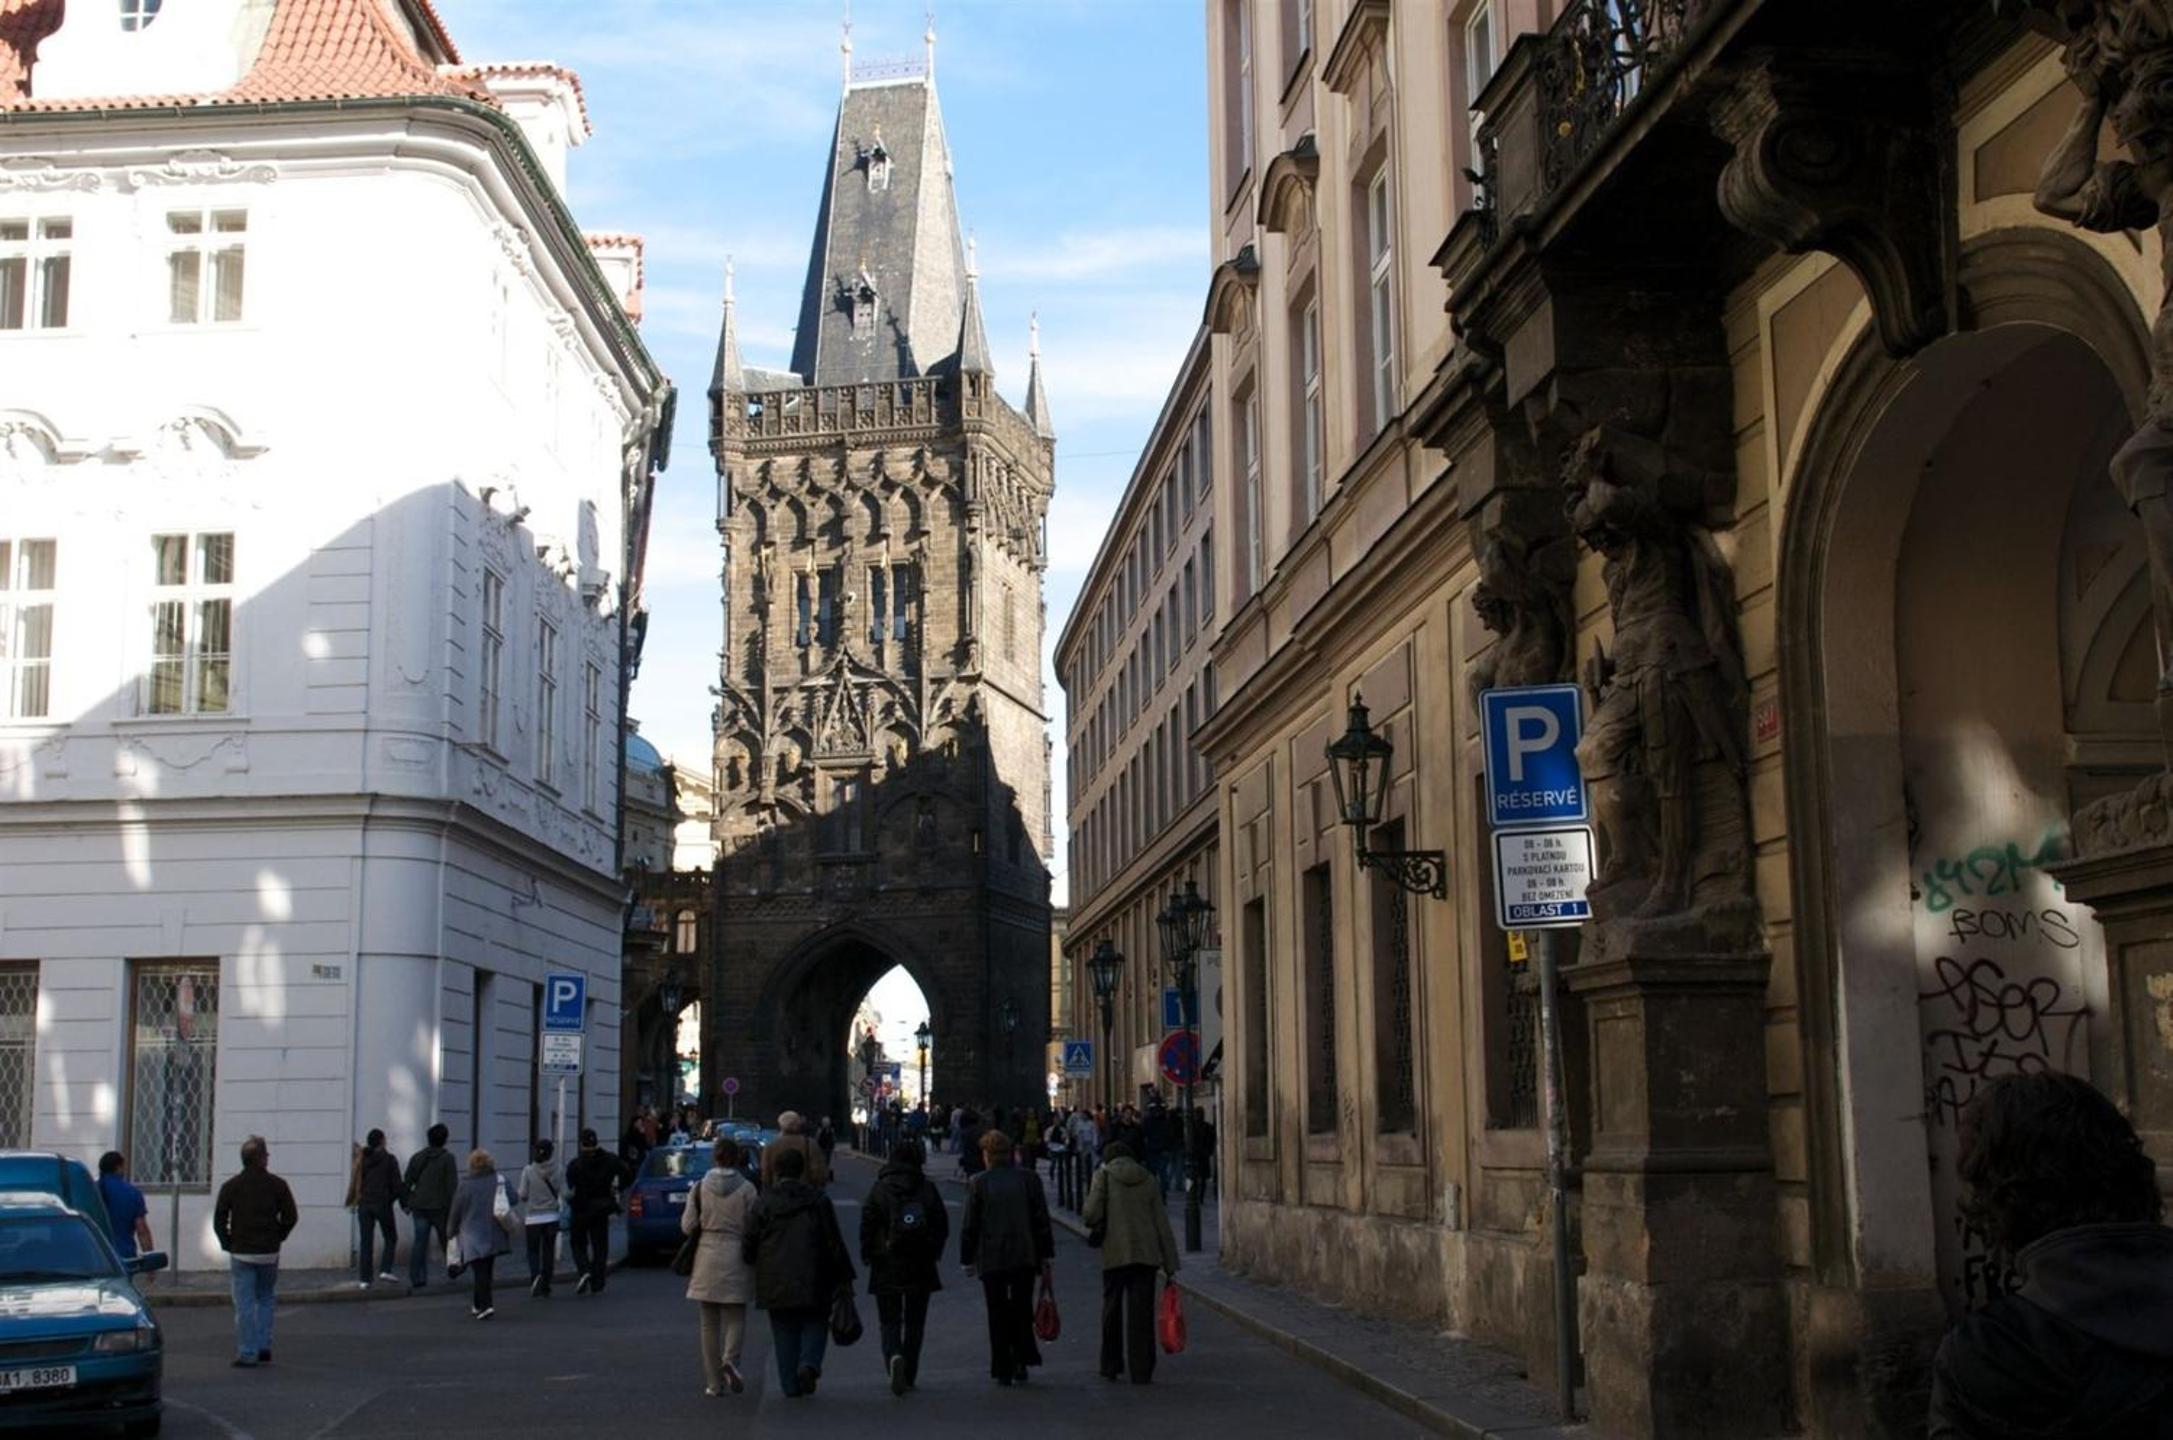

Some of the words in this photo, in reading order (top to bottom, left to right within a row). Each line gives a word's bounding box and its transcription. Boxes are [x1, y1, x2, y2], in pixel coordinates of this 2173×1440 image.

[1505, 706, 1560, 781] P
[1513, 903, 1563, 918] OBLAST
[1572, 903, 1578, 914] 1
[553, 980, 577, 1014] P
[33, 1368, 69, 1385] 8380
